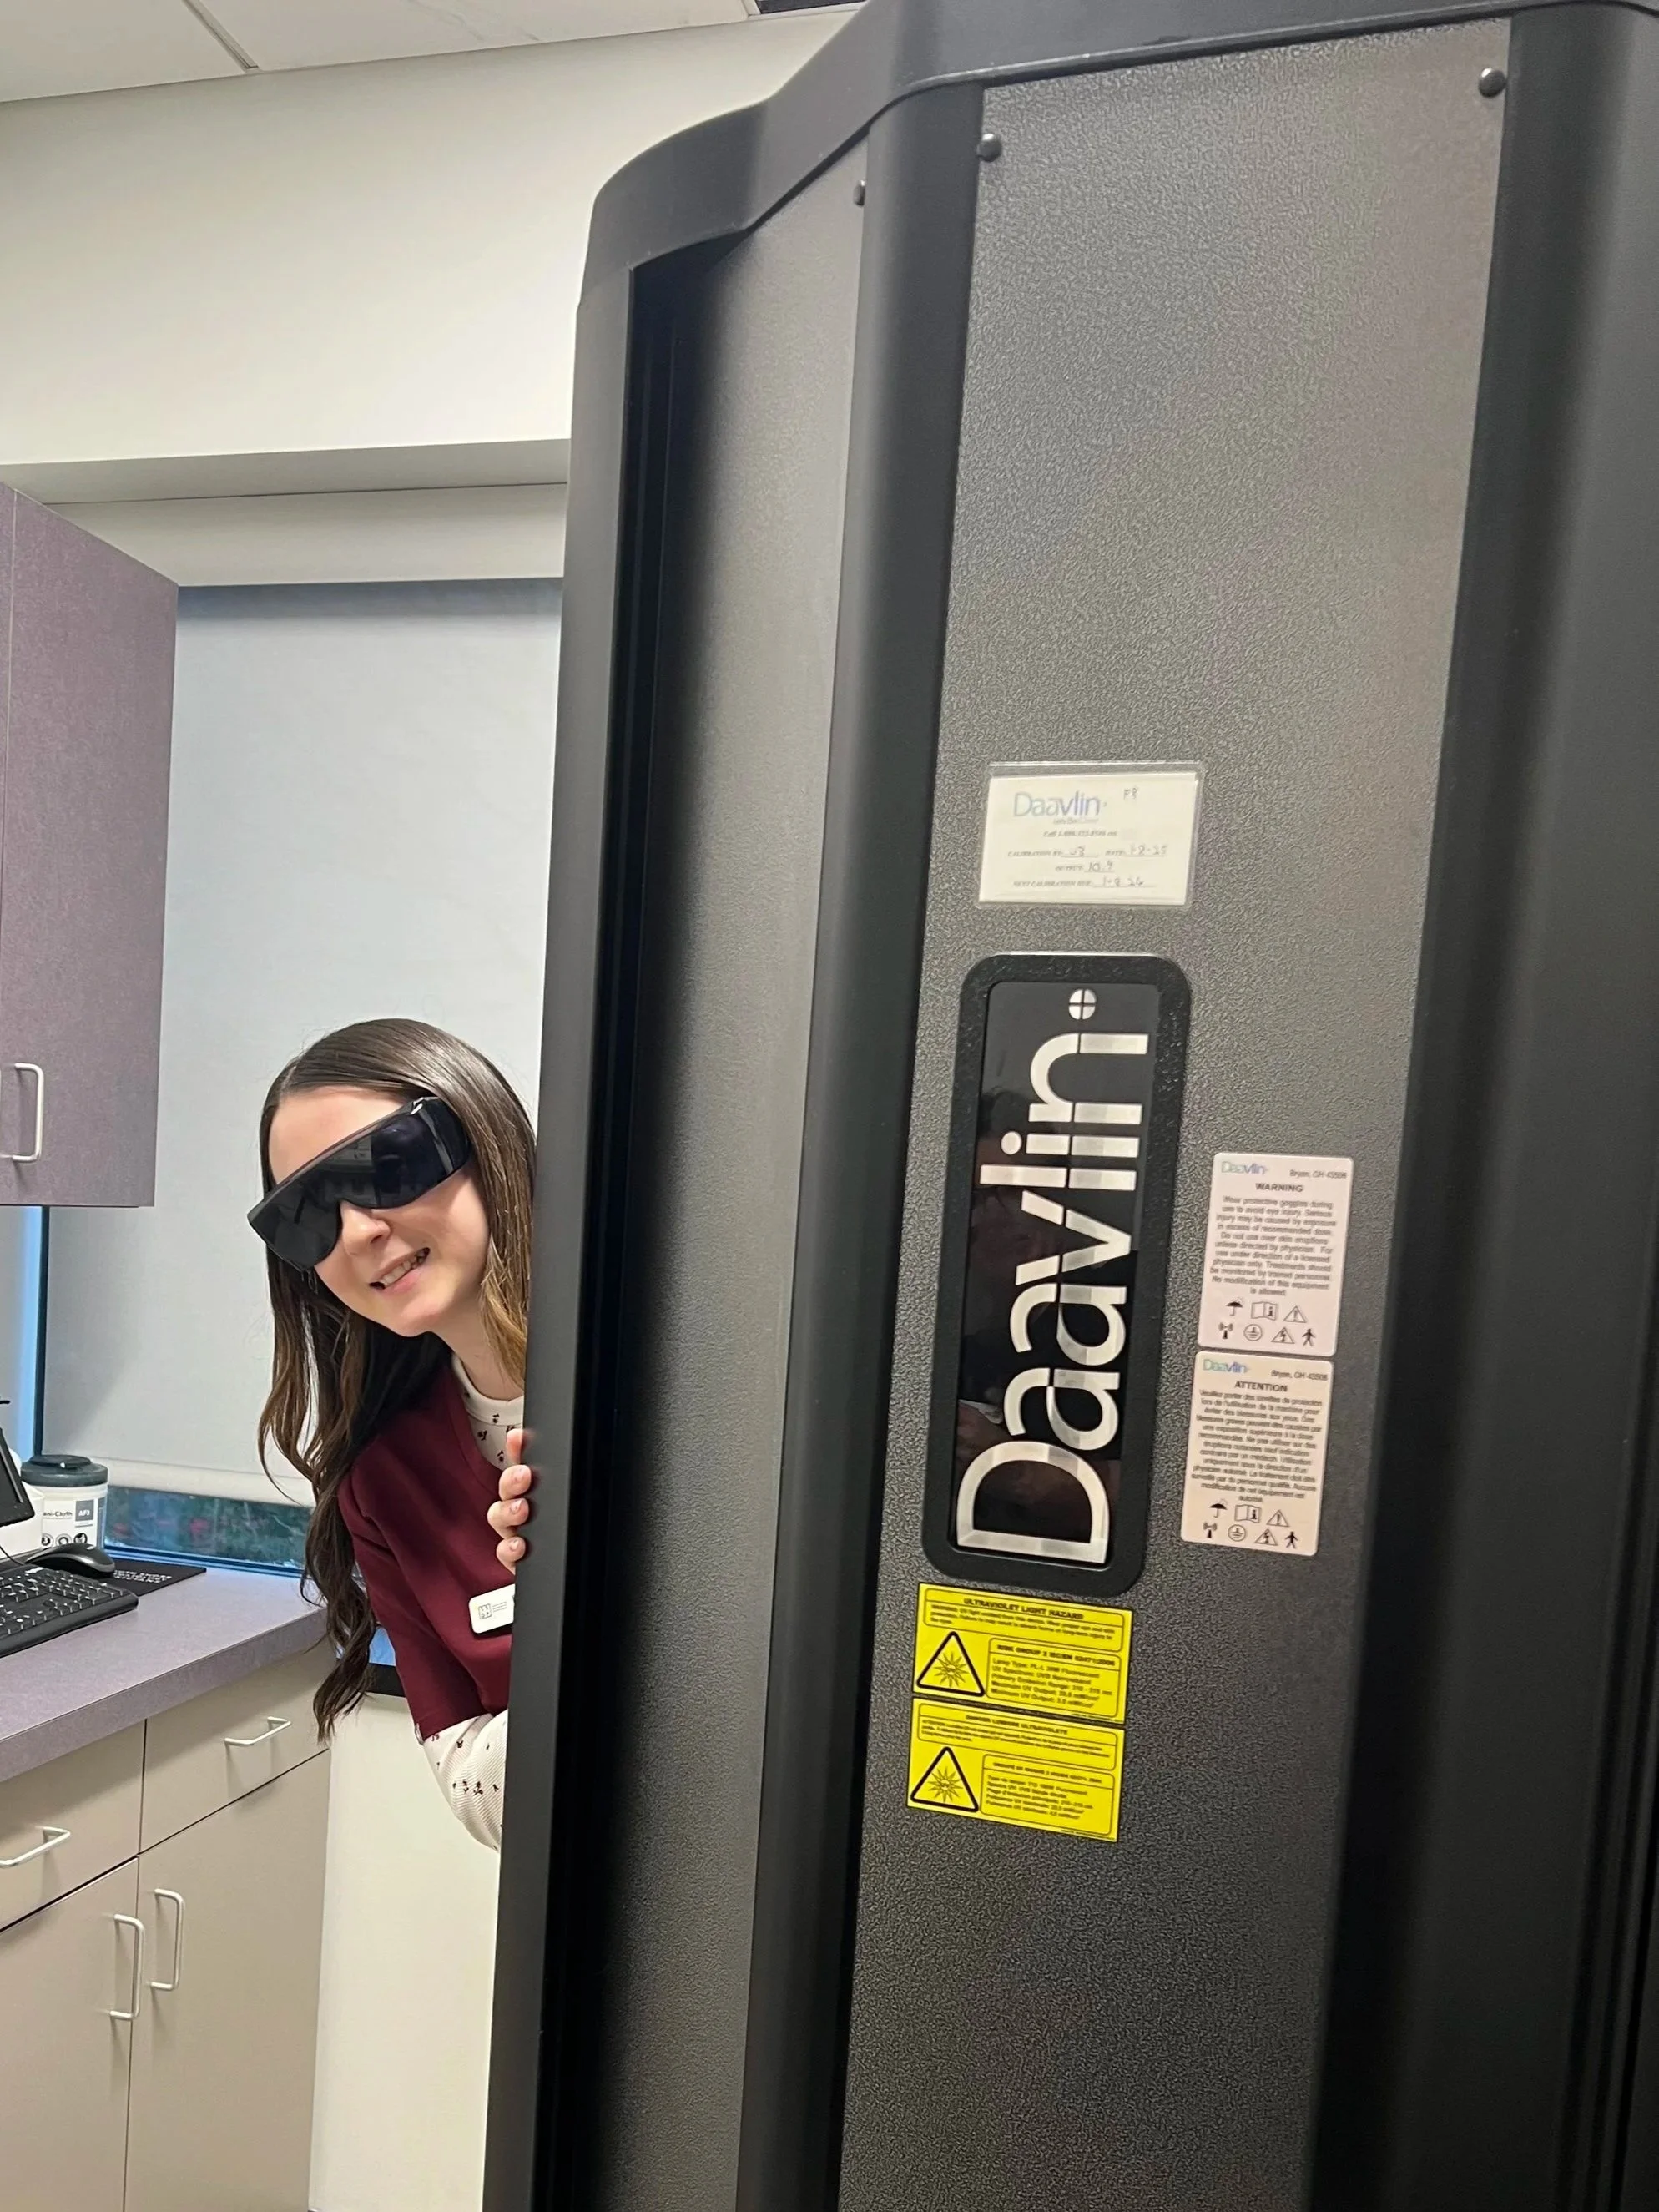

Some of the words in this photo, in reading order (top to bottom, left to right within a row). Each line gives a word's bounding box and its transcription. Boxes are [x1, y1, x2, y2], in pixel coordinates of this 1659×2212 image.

[1013, 790, 1100, 817] Daavlin
[1222, 1160, 1266, 1175] Daavlin
[1254, 1182, 1304, 1193] WARNING
[956, 1033, 1150, 1564] Daavlin
[1203, 1358, 1248, 1374] Daavlin
[1234, 1380, 1288, 1393] ATTENTION
[963, 1598, 1020, 1612] ULTRAVIOLET
[1021, 1605, 1047, 1616] LIGHT
[1049, 1609, 1084, 1620] HAZARD
